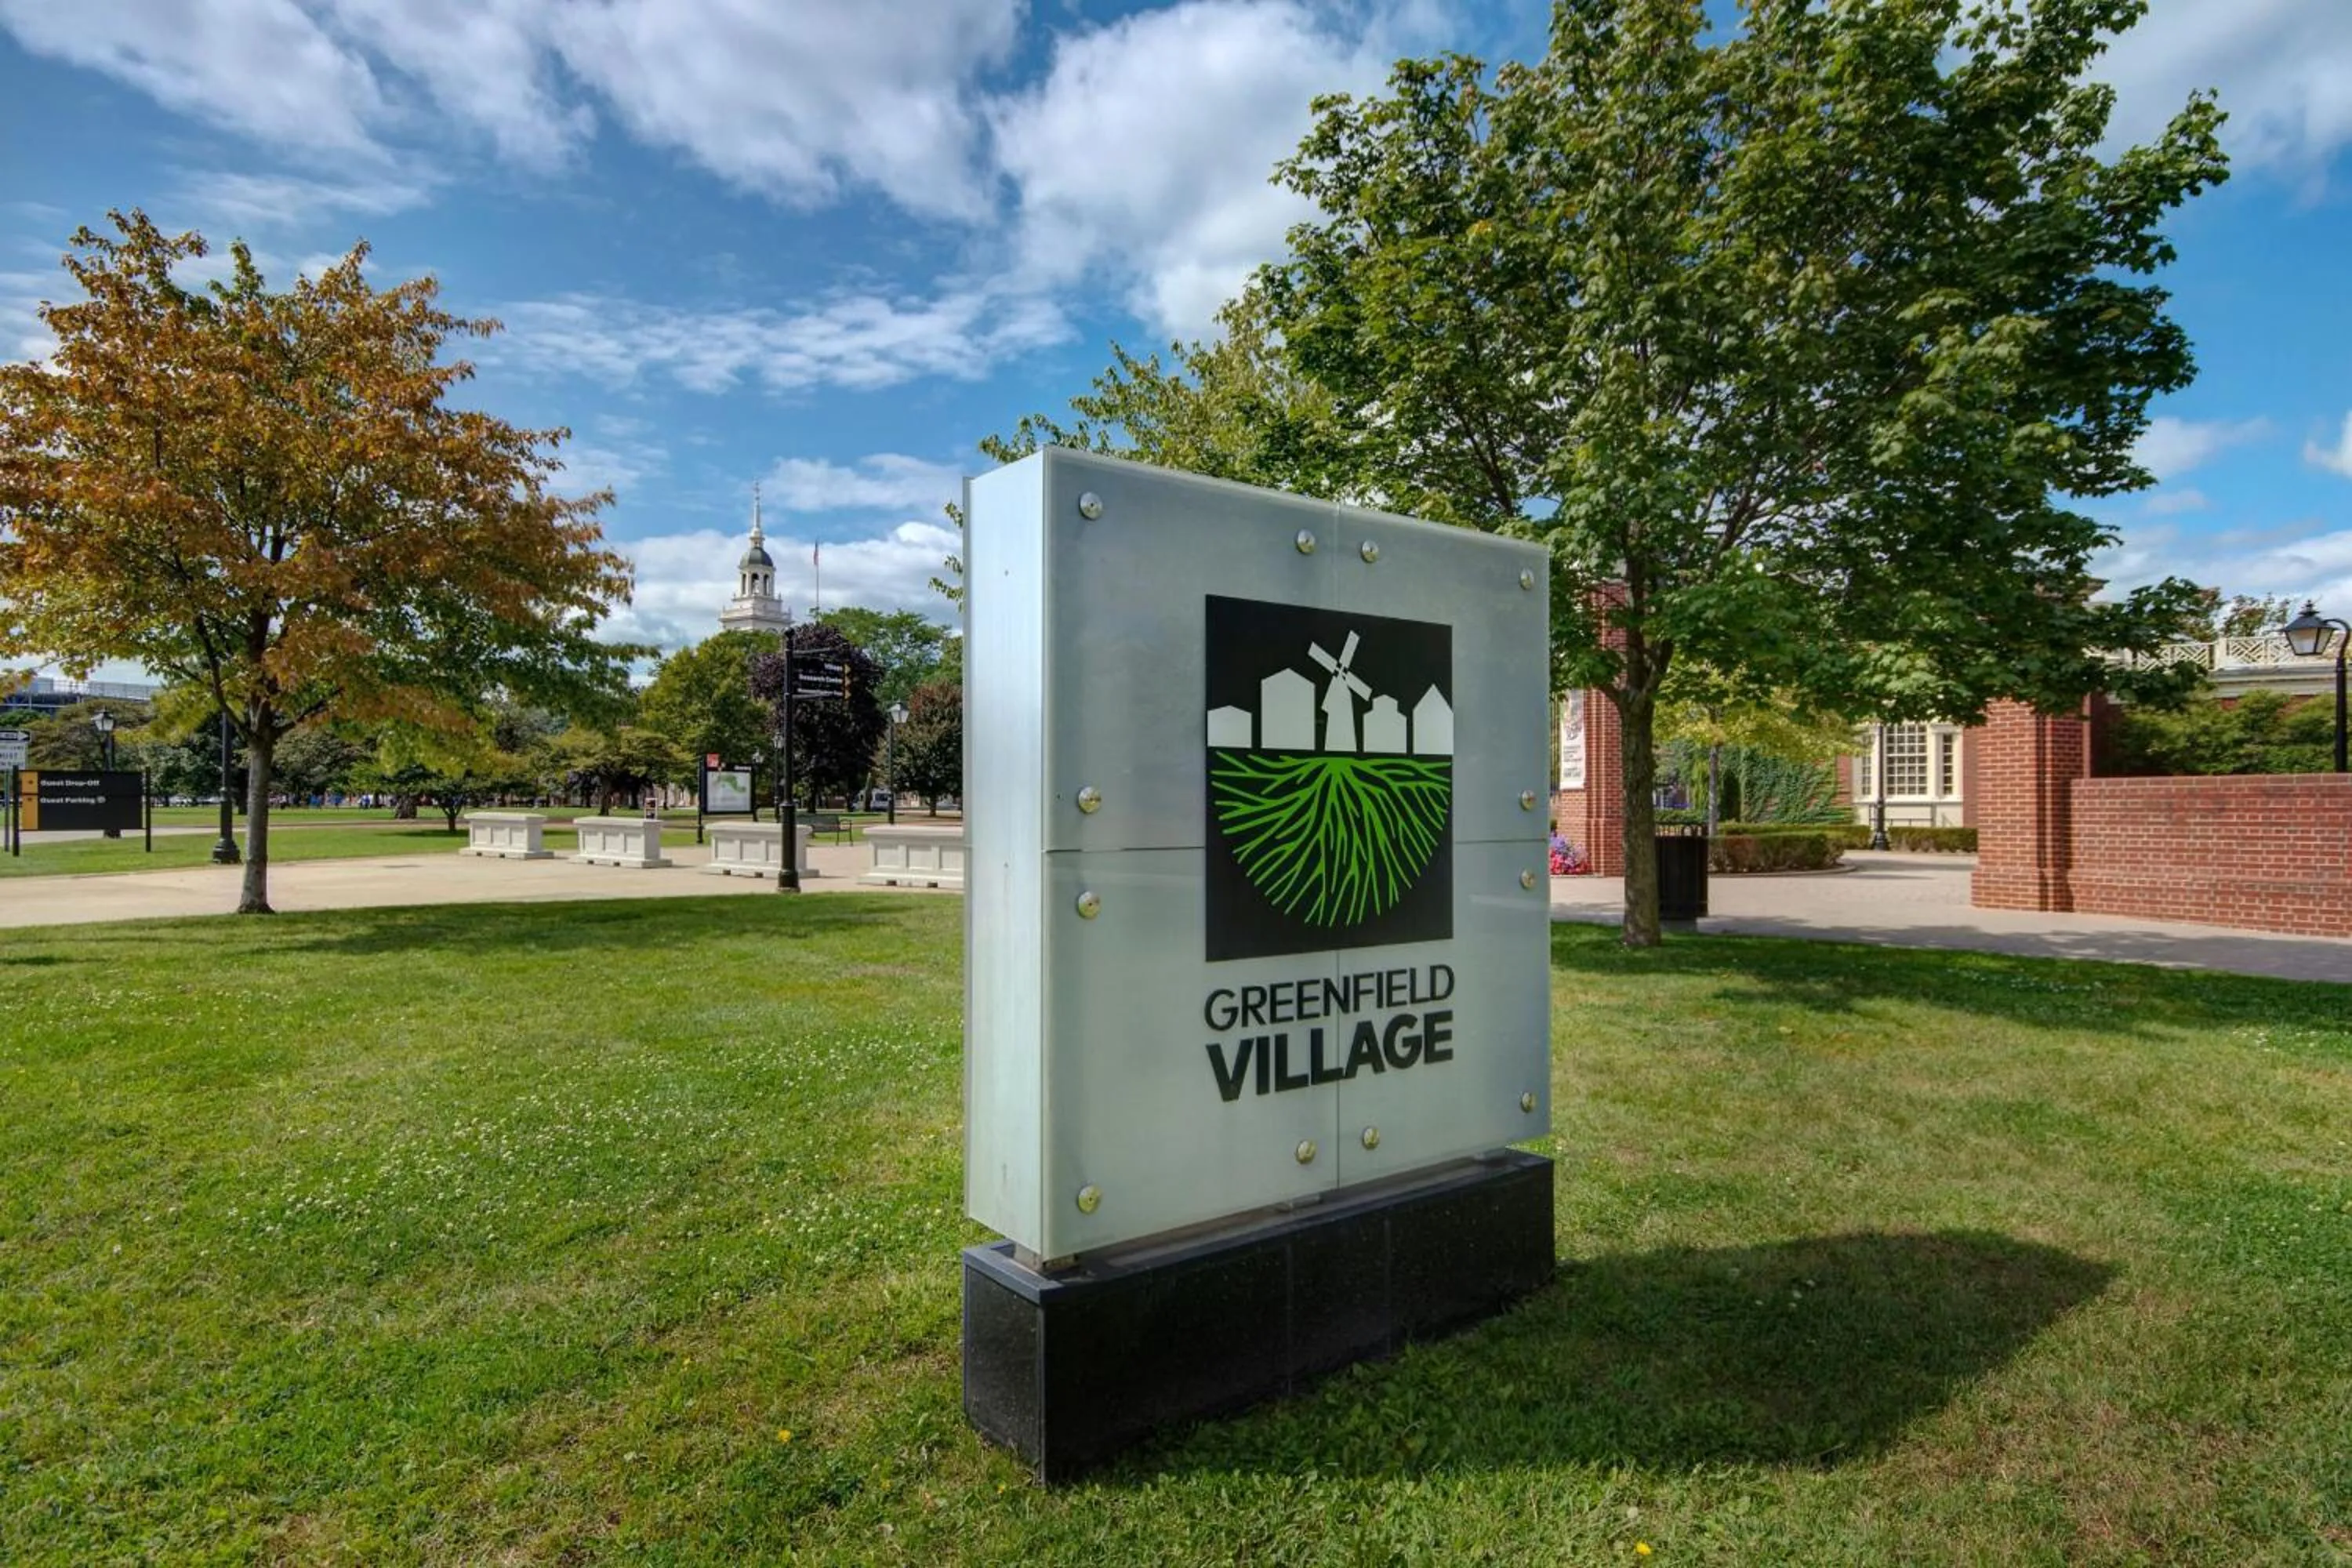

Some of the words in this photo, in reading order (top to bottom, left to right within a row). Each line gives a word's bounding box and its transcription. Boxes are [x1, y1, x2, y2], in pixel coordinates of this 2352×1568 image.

[65, 796, 96, 805] Parking
[1204, 964, 1455, 1032] GREENFIELD
[1205, 1010, 1454, 1103] VILLAGE
